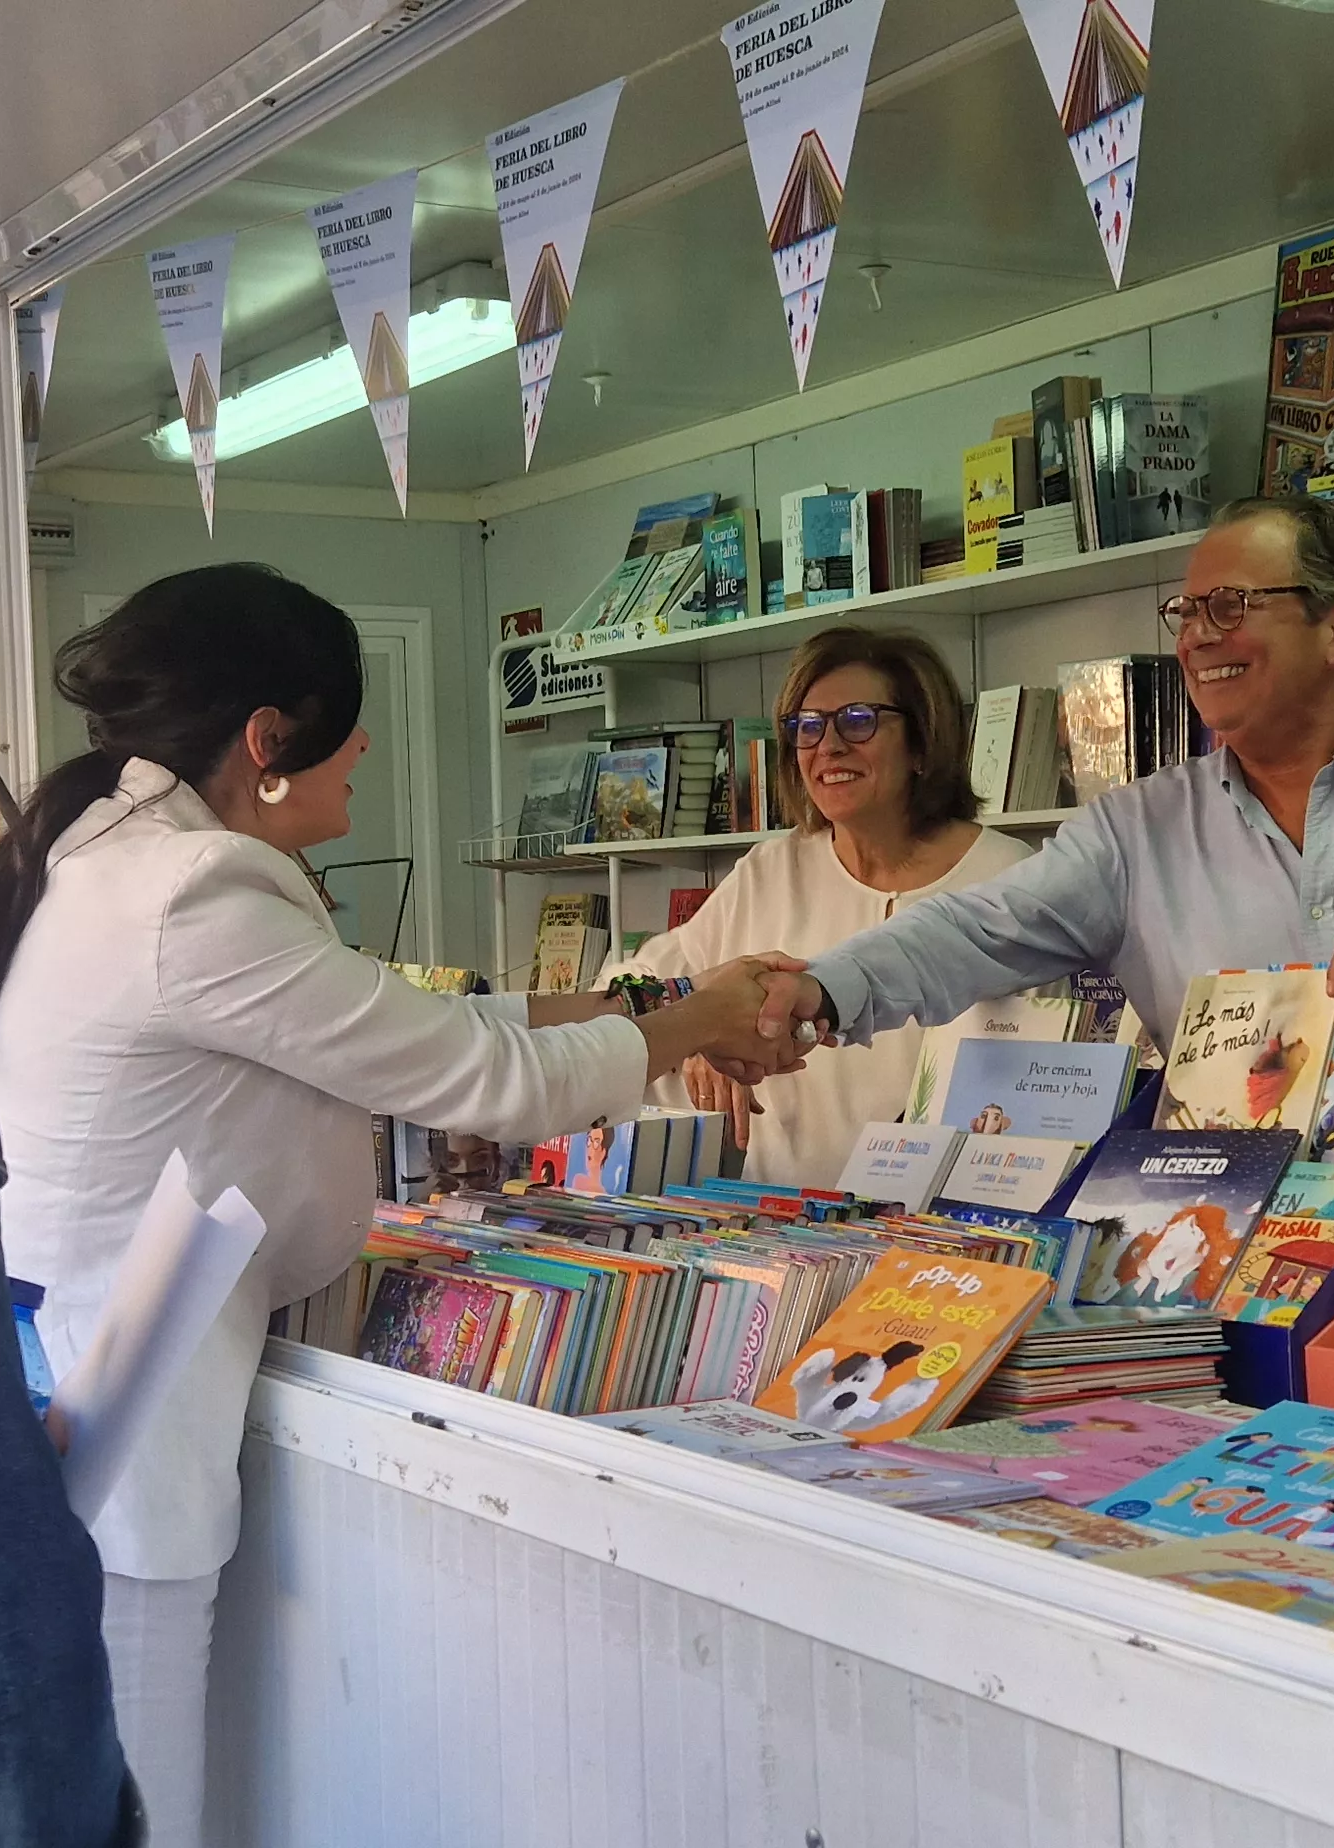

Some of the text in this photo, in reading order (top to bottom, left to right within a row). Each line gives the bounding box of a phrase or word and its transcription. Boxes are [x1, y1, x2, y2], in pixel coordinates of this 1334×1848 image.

[735, 28, 776, 60] FERIA
[779, 13, 809, 38] DEL
[736, 35, 813, 83] DE HUESCA
[495, 122, 587, 171] FERIA DEL LIBRO
[495, 158, 555, 192] DE HUESCA
[317, 206, 393, 239] FERIA DEL LIBRO
[320, 234, 371, 260] DE HUESCA
[1160, 411, 1174, 422] LA
[1286, 405, 1322, 433] LIBRO
[1144, 424, 1190, 439] DAMA
[1158, 443, 1179, 454] DEL
[1143, 455, 1196, 472] PRADO
[709, 525, 739, 544] Cuando
[719, 544, 739, 559] falte
[715, 577, 738, 597] aire
[541, 669, 595, 697] ediciones
[1220, 1000, 1256, 1023] más
[984, 1019, 1020, 1033] Secretos
[1175, 1020, 1271, 1068] de lo más!
[1028, 1061, 1092, 1078] Por encima
[1015, 1080, 1098, 1099] de rama y hoja
[1139, 1158, 1229, 1175] UN CEREZO
[907, 1264, 983, 1298] pop-up
[874, 1317, 938, 1342] ¡Guau!
